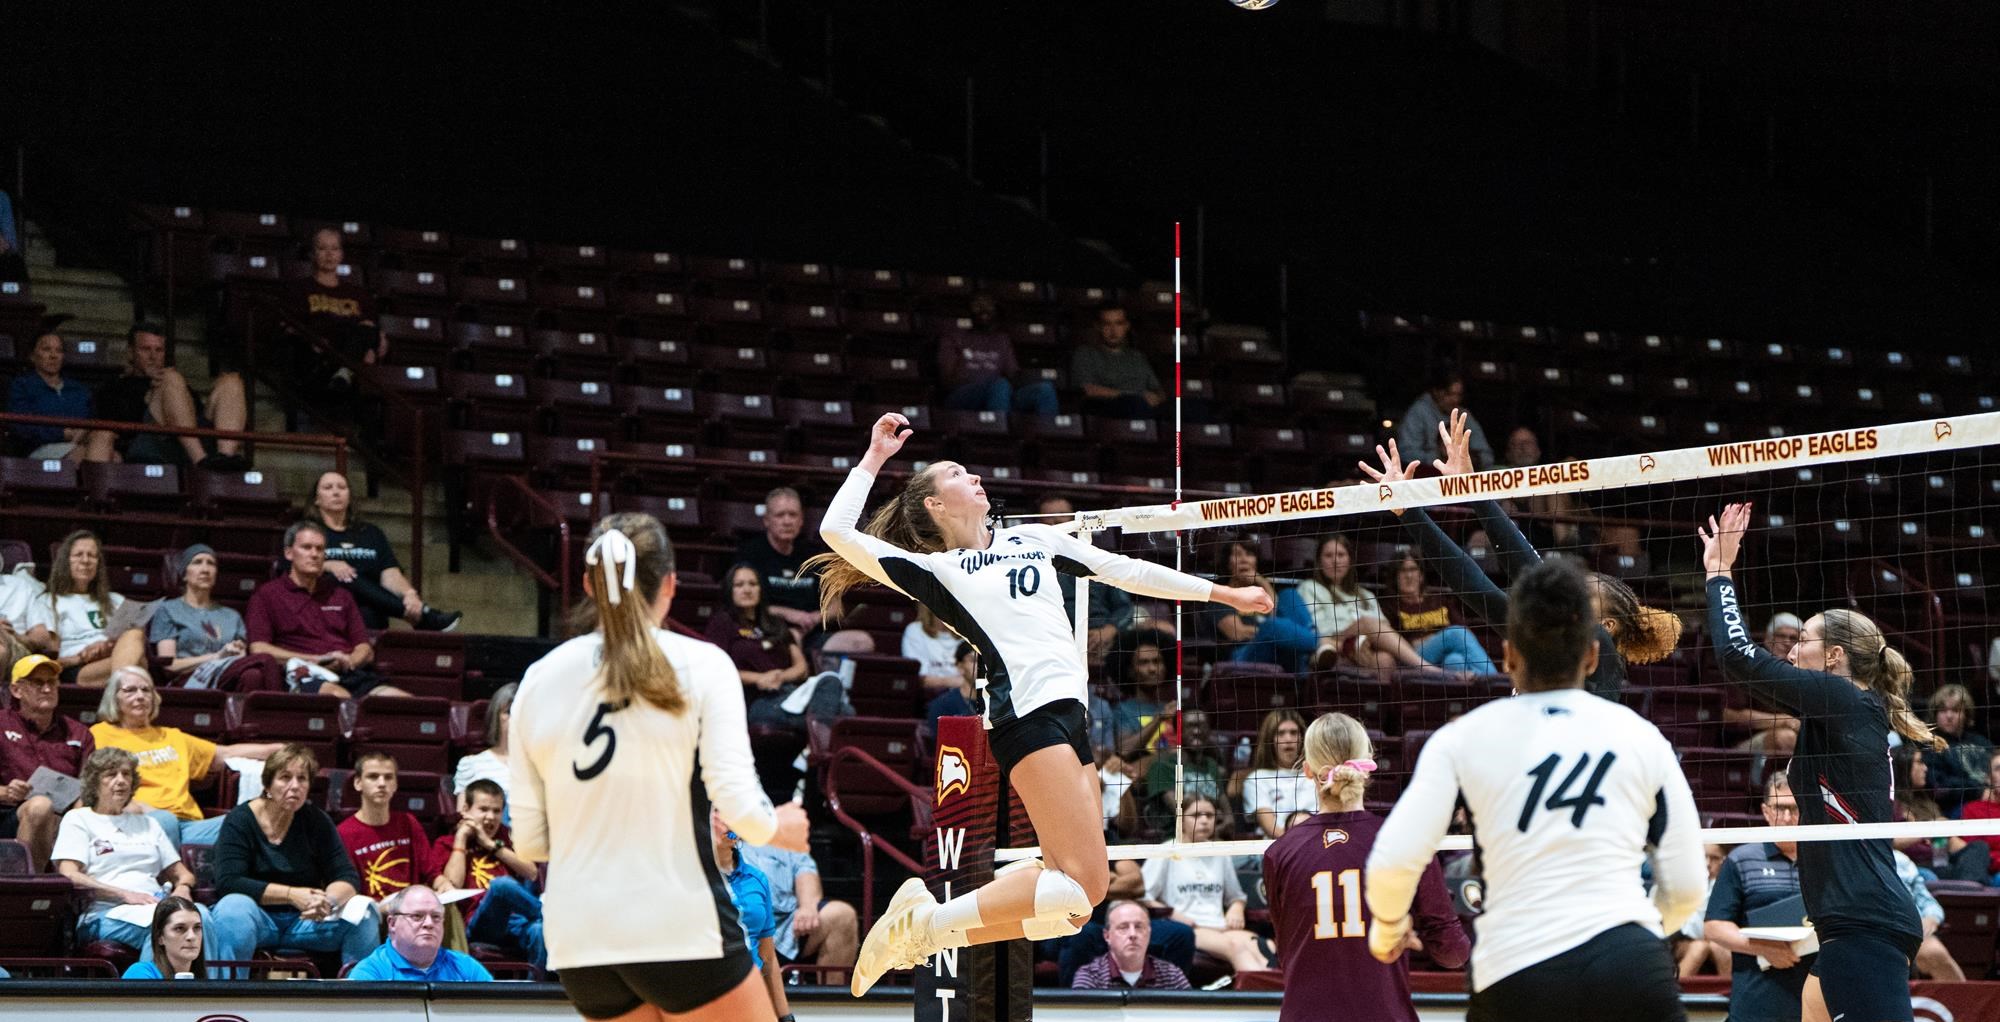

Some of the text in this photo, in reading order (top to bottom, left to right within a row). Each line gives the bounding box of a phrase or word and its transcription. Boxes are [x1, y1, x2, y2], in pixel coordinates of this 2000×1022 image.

[1707, 429, 1878, 467] WINTHROP EAGLES
[1439, 462, 1590, 497] WINTHROP EAGLES
[1200, 490, 1335, 521] WINTHROP EAGLES
[1005, 565, 1040, 599] 10
[573, 698, 631, 781] 5
[1518, 751, 1616, 832] 14
[1311, 868, 1366, 940] 11
